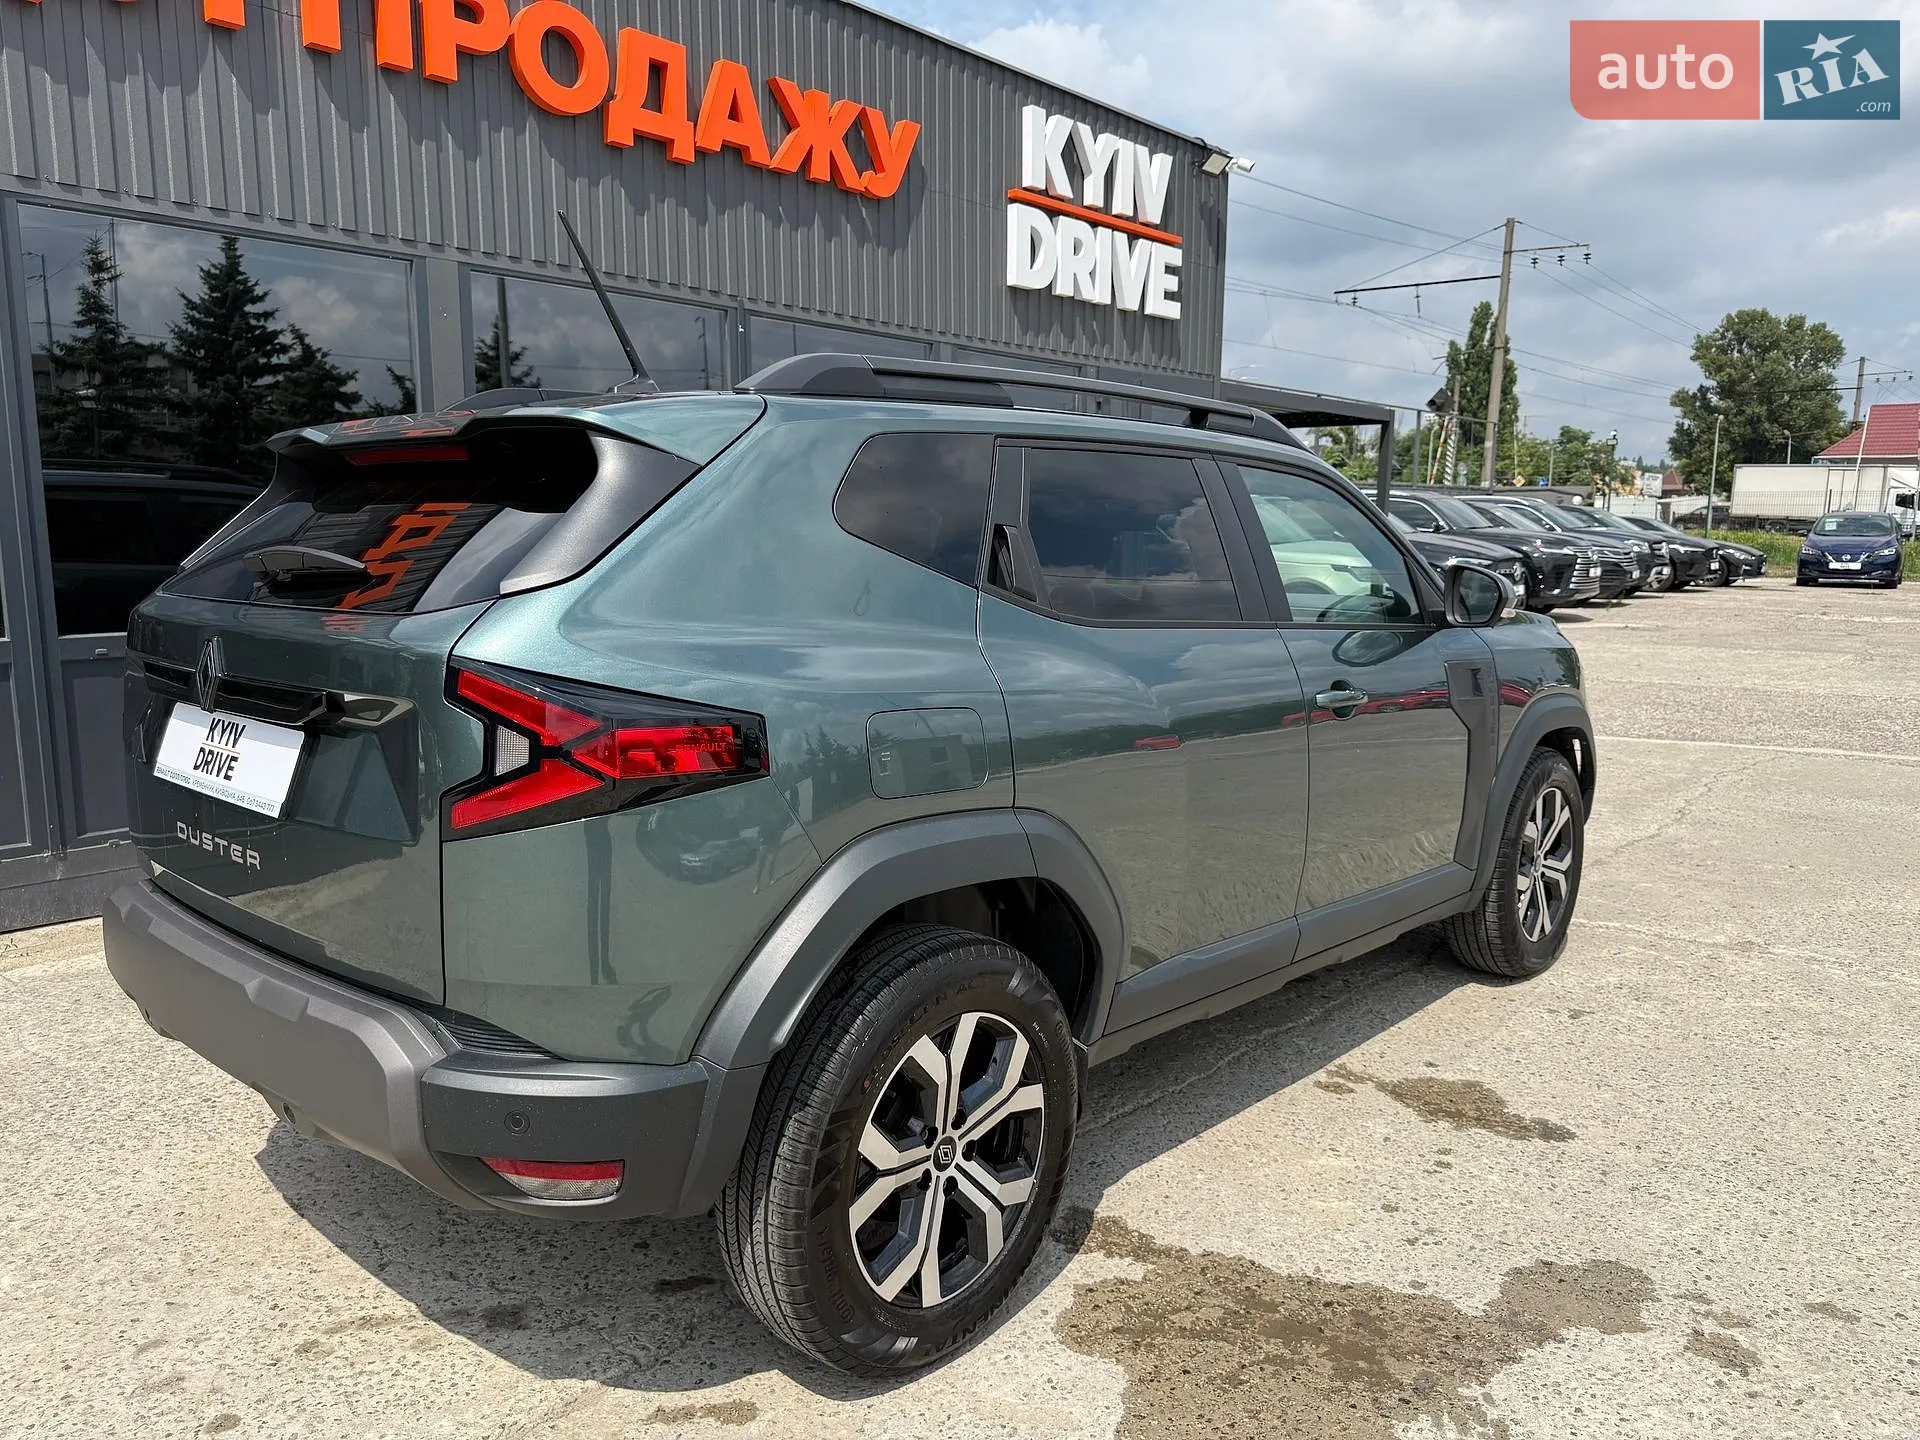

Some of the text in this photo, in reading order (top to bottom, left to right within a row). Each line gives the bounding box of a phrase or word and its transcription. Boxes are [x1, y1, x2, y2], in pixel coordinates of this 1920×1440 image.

[1022, 104, 1173, 225] KYIV
[1007, 202, 1183, 320] DRIVE
[206, 717, 247, 749] KYIV
[193, 746, 239, 781] DRIVE
[177, 821, 260, 870] DUSTER
